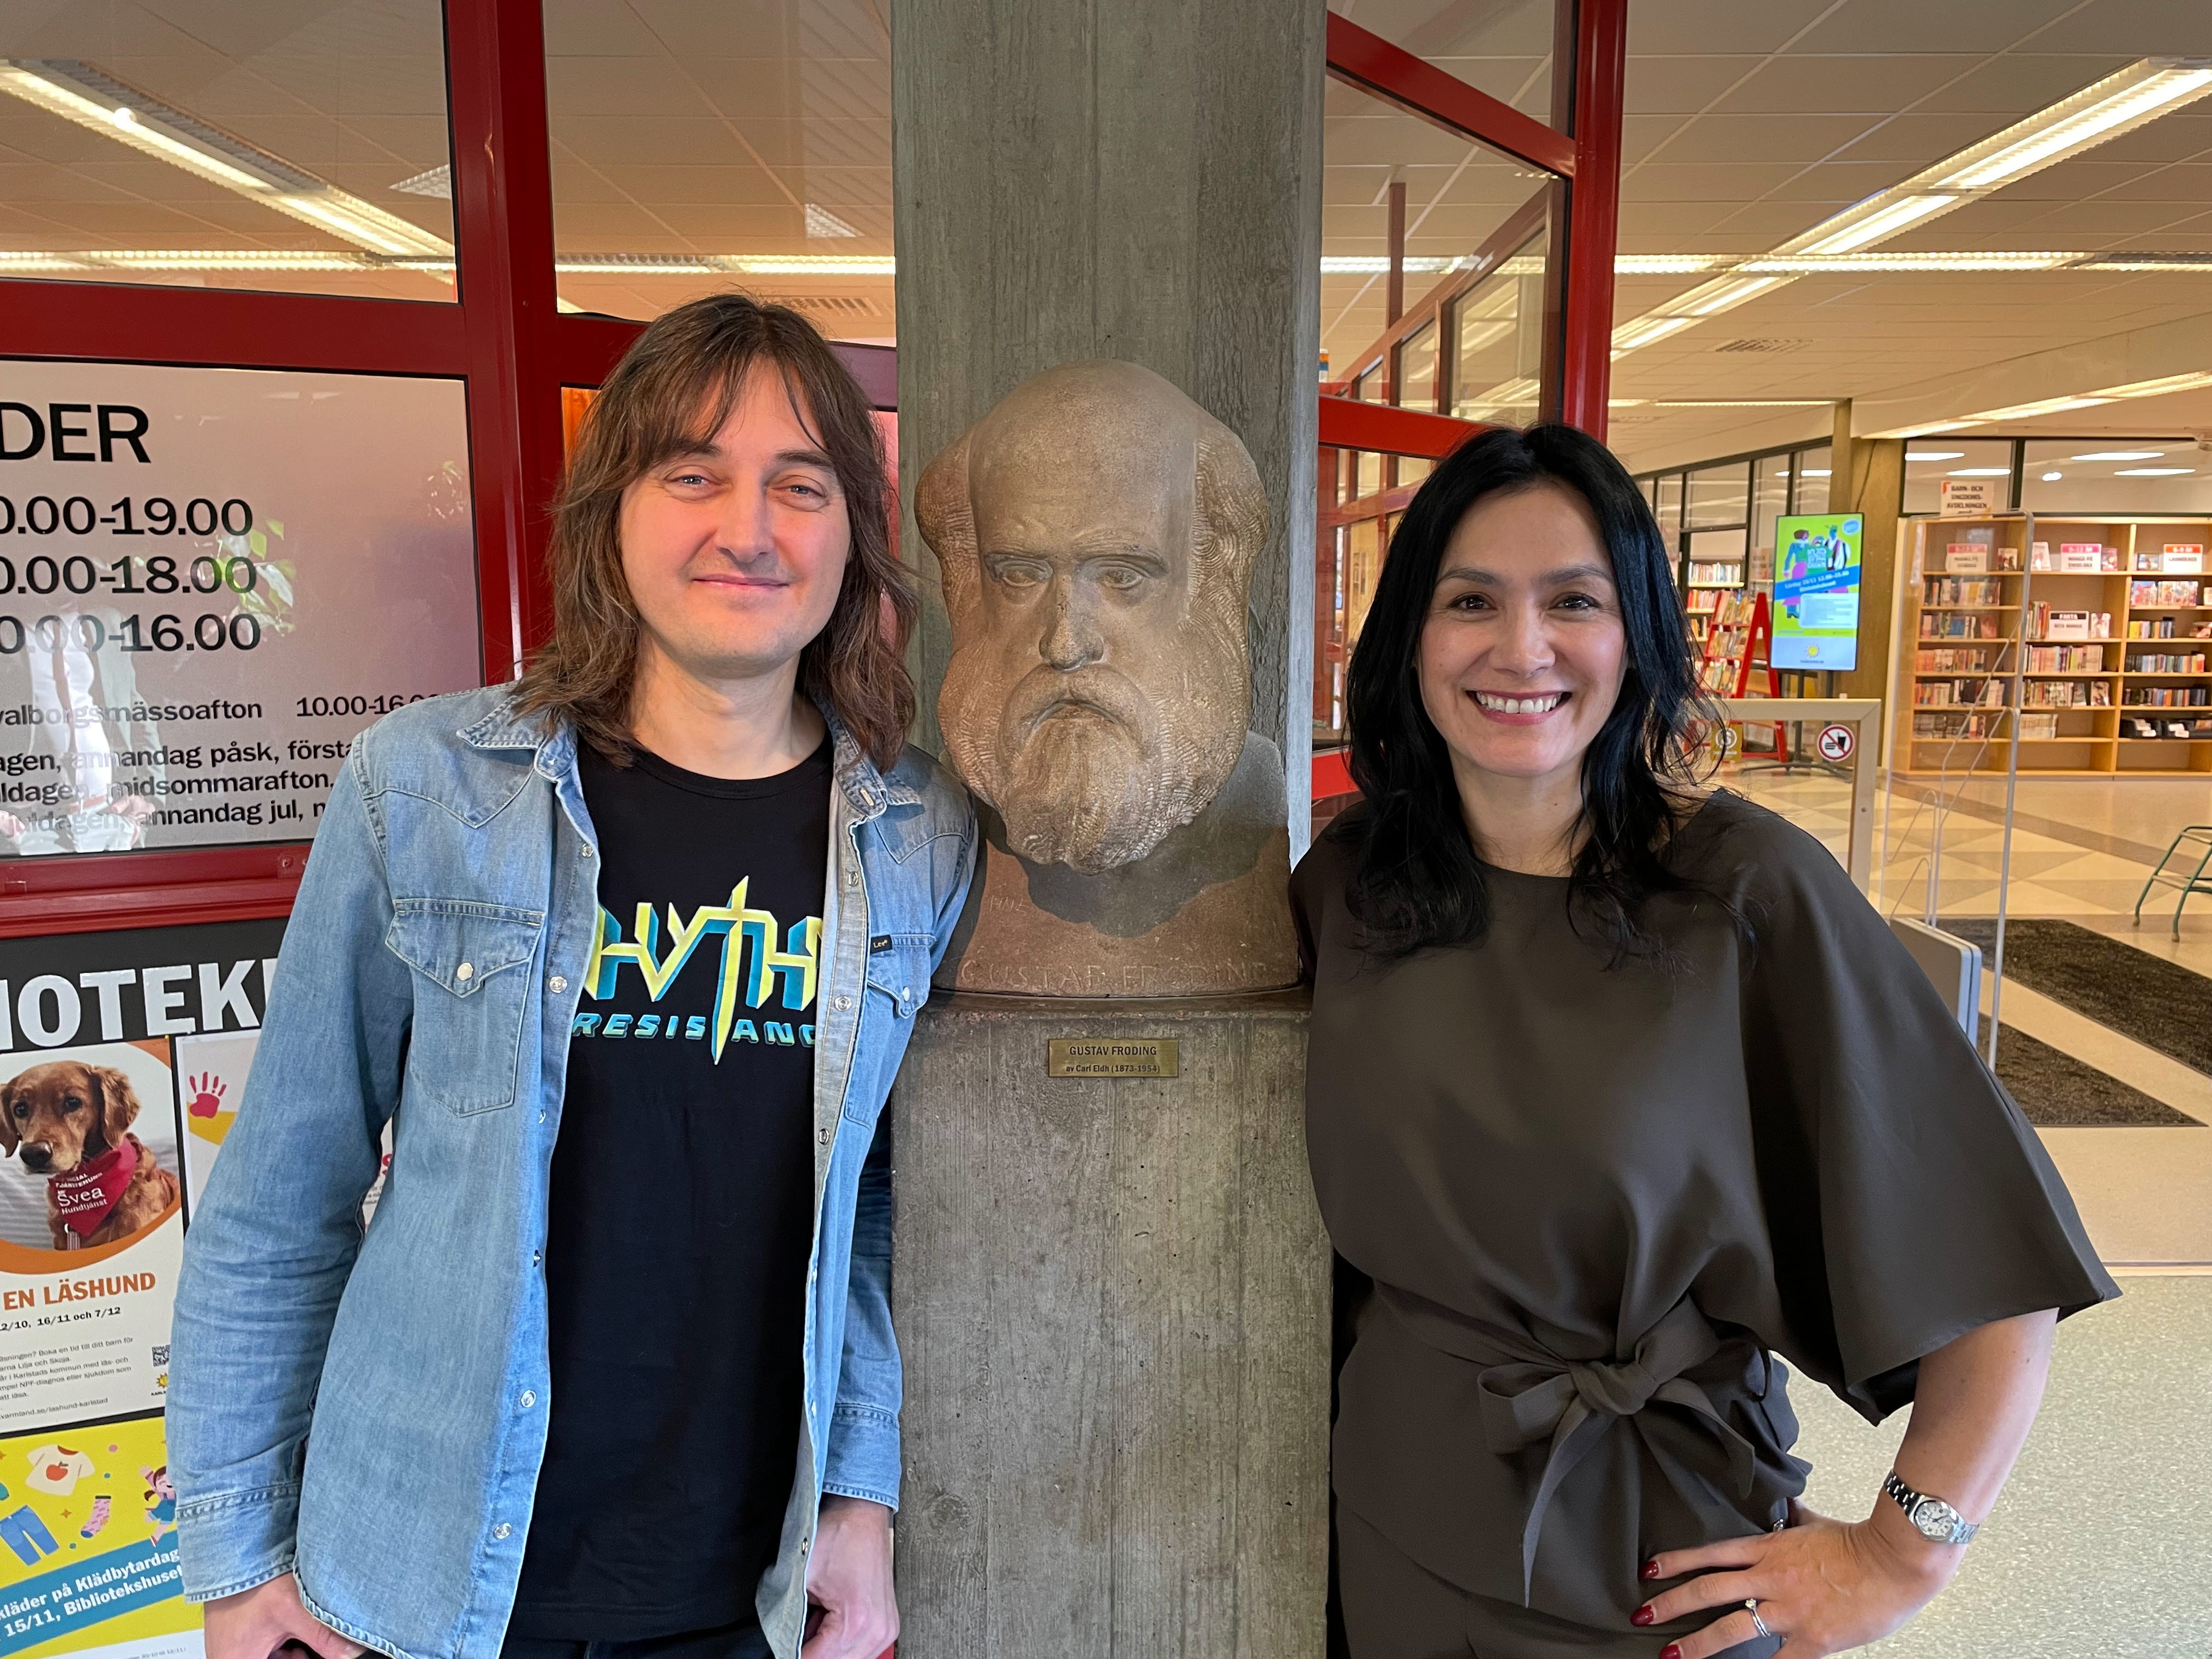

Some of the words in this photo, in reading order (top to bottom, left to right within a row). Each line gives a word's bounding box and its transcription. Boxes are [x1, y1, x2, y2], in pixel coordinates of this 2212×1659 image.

[0, 402, 151, 464] DER
[0, 699, 262, 729] alborgsmässoafton
[211, 741, 279, 768] påsk,
[269, 799, 303, 825] jul,
[0, 958, 278, 1049] OTEK
[1069, 1046, 1109, 1056] GUSTAV
[1111, 1065, 1160, 1074] (1873-1954)
[57, 1187, 105, 1207] Svea
[3, 1288, 35, 1311] EN
[43, 1272, 156, 1306] LÄSHUND
[0, 1320, 31, 1331] 2/10,
[37, 1314, 71, 1327] 16/11
[73, 1311, 92, 1320] och
[94, 1306, 121, 1318] 7/12
[51, 1583, 74, 1604] på
[75, 1548, 180, 1592] Klädbytardag
[4, 1609, 61, 1638] 15/11,
[63, 1564, 182, 1616] Bibliotekshuset
